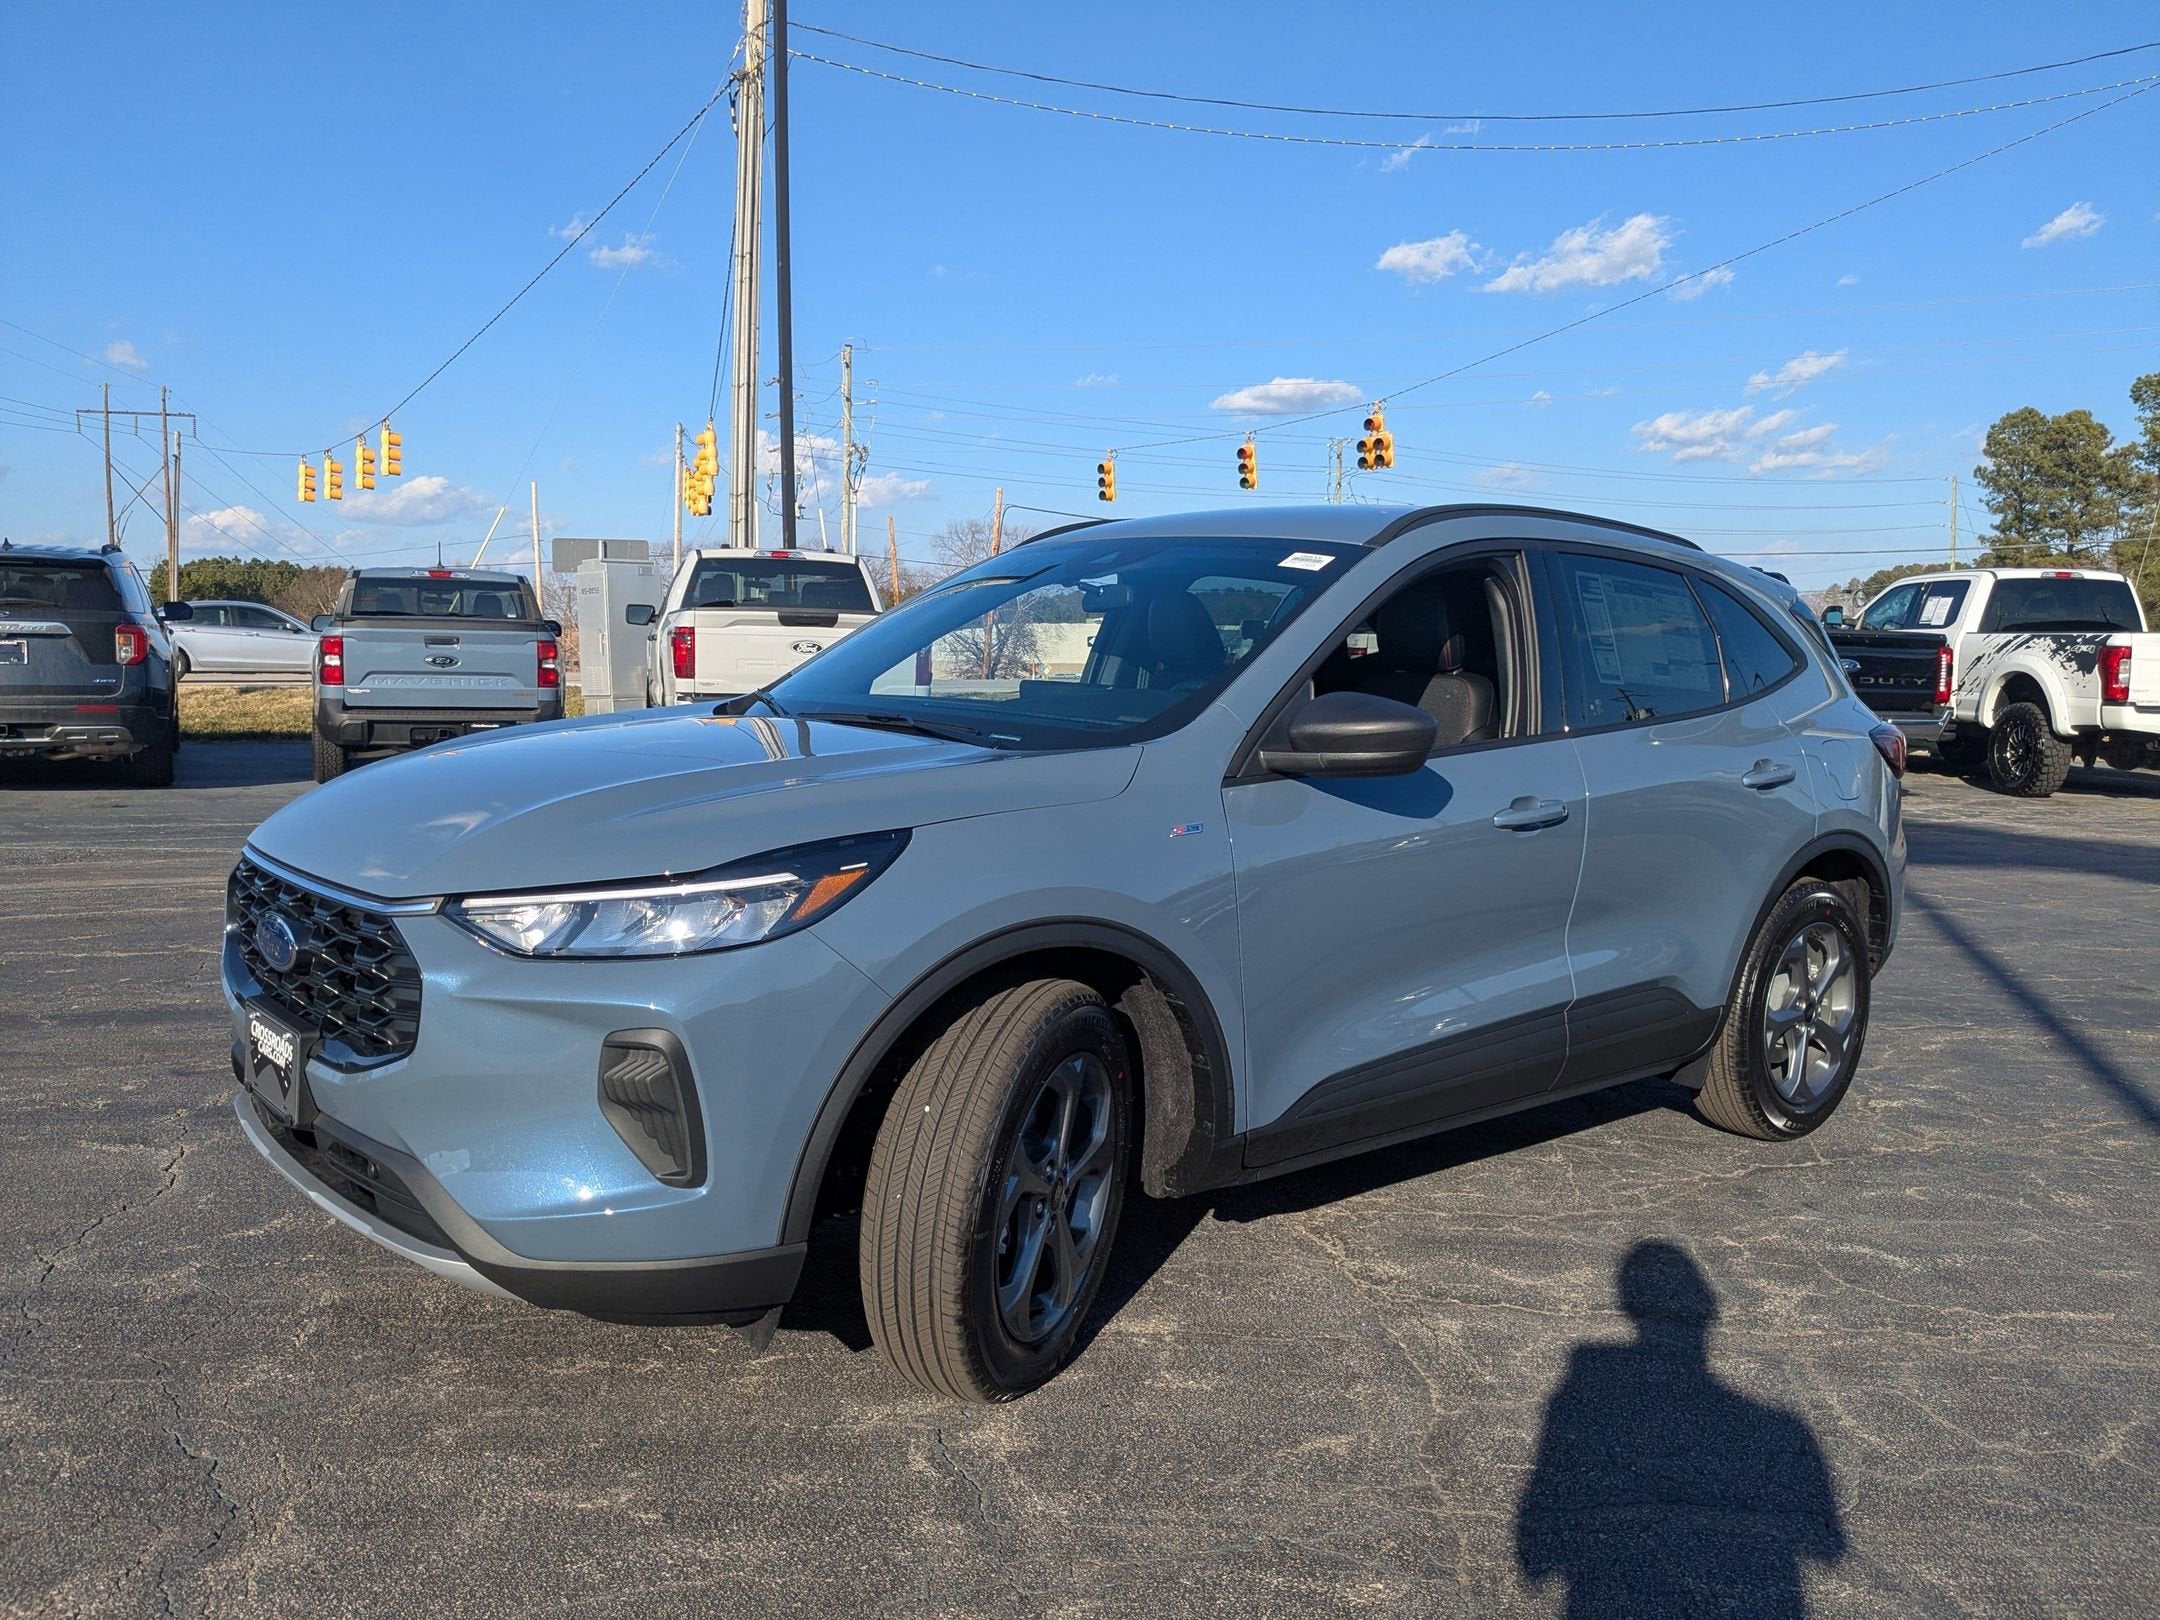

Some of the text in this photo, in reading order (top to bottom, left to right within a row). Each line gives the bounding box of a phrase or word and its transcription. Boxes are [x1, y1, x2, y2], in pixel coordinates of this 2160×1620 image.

[796, 643, 818, 654] Ford
[373, 677, 512, 687] MAVERICK
[1859, 676, 1927, 686] DUTY
[251, 1020, 293, 1062] CROSSROADS
[258, 1041, 286, 1069] CARS.COM
